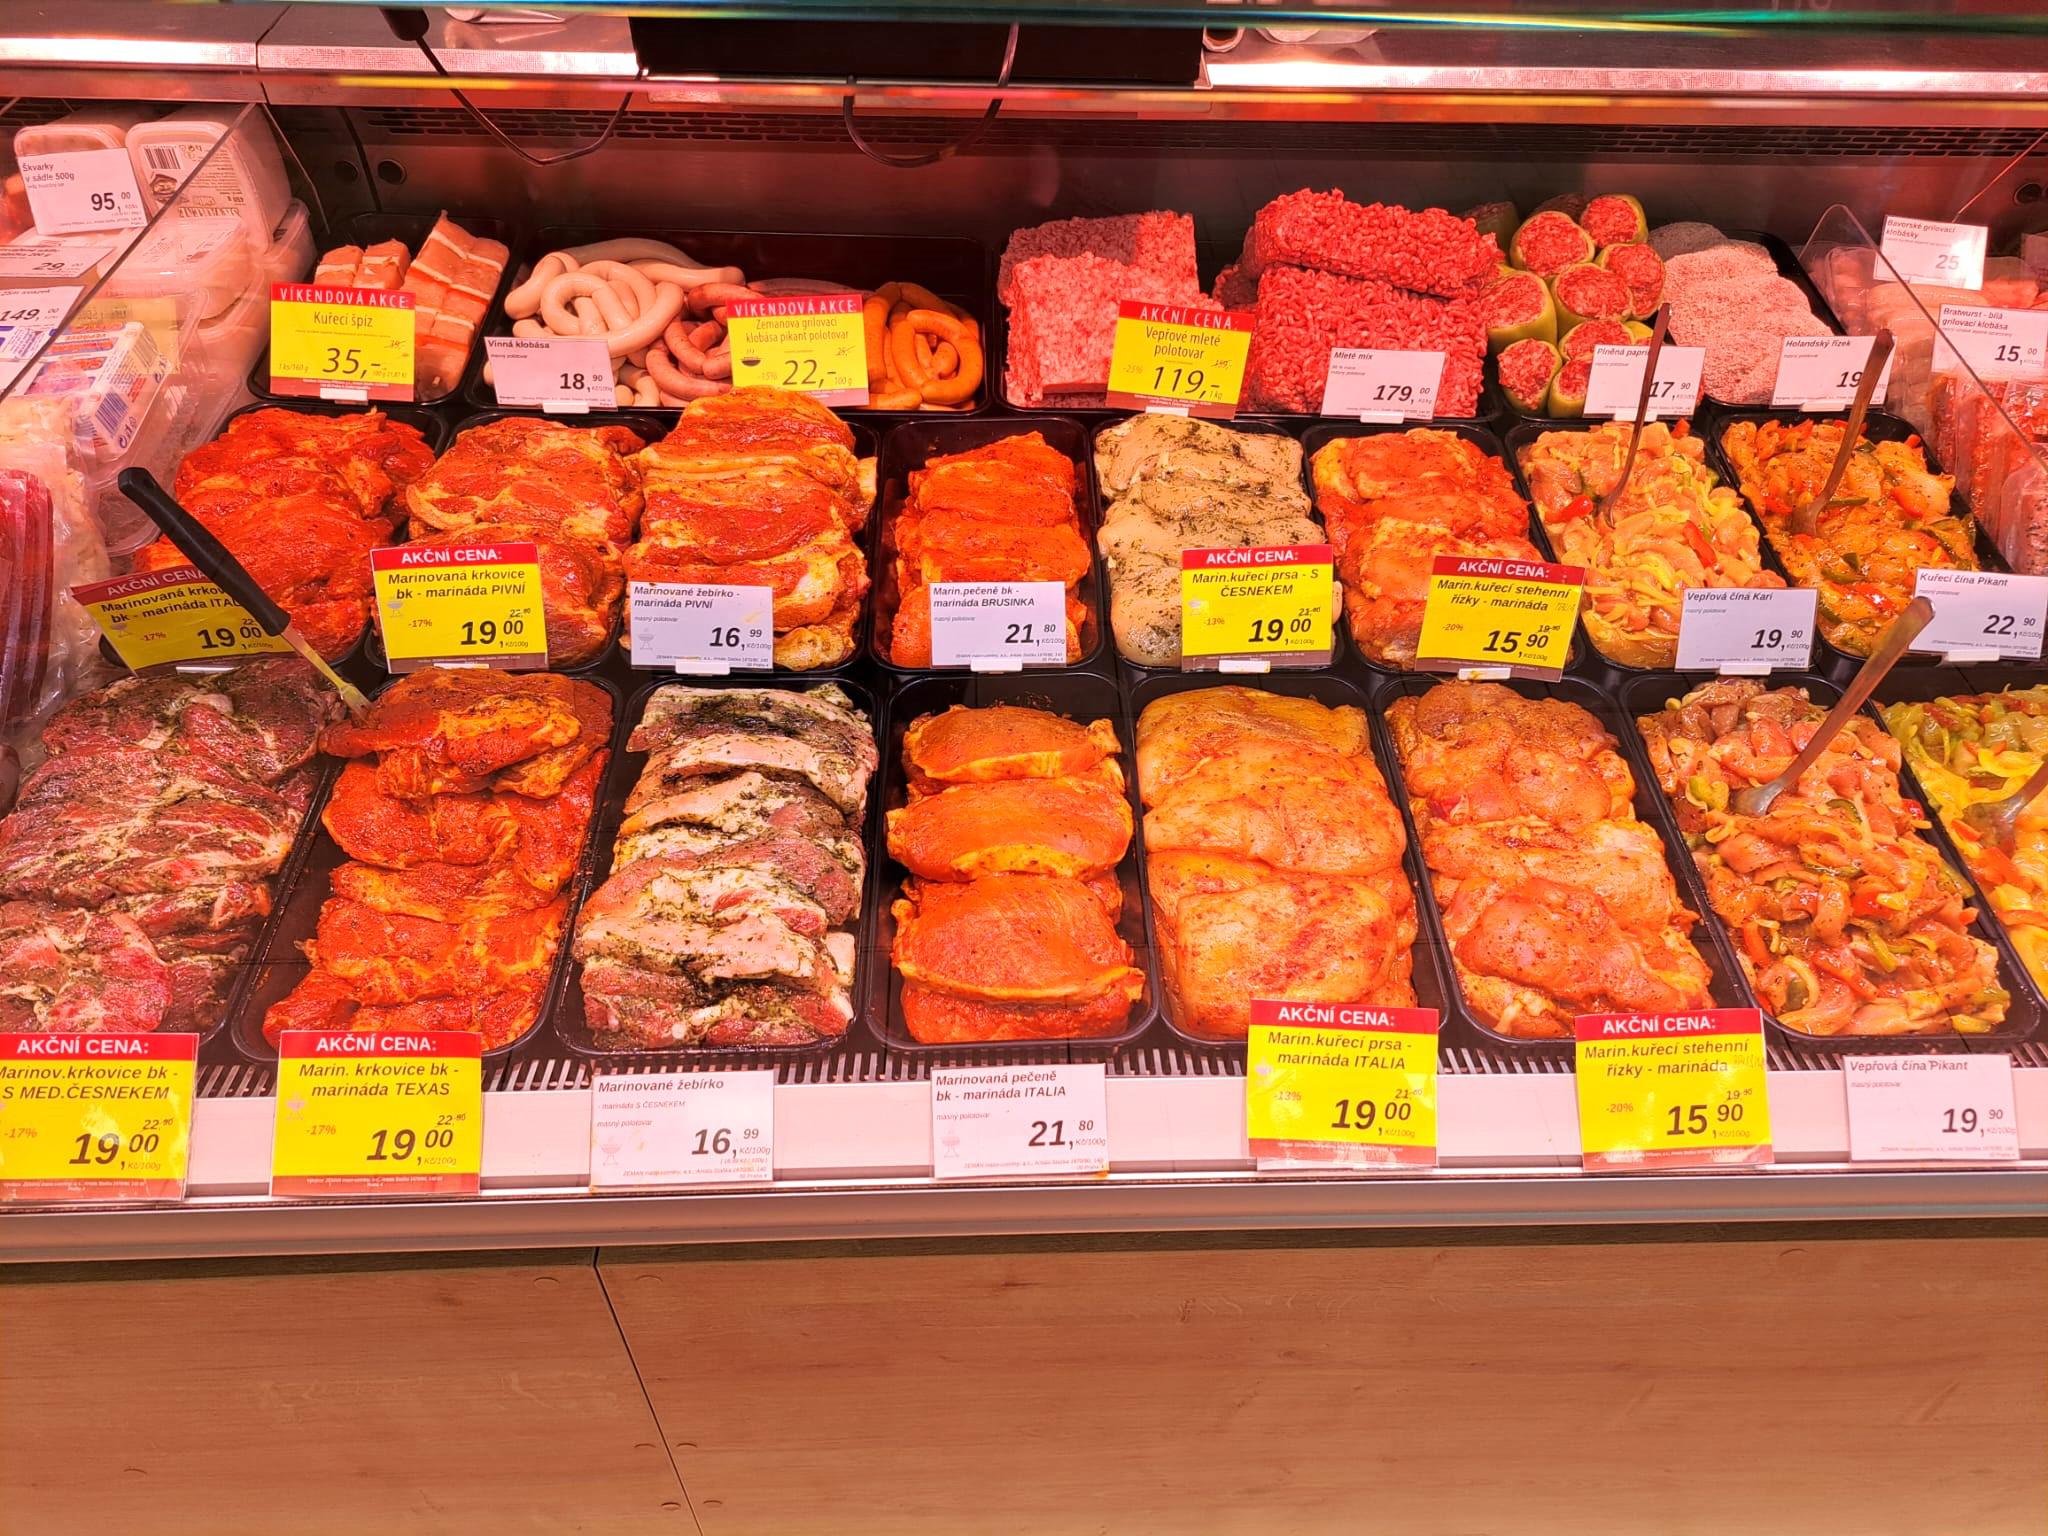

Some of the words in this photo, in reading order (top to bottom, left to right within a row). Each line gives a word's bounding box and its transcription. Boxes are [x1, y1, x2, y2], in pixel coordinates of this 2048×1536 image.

[22, 162, 54, 172] Škvarky
[32, 173, 54, 181] sádle
[55, 172, 75, 181] 500g
[1885, 229, 1919, 239] klobásky
[1887, 220, 1922, 230] Bavorské
[1923, 224, 1956, 233] grilovací
[280, 287, 364, 305] VÍKENDOVÁ
[735, 300, 815, 317] VÍKENDOVÁ
[1140, 306, 1188, 325] AKČNÍ
[1943, 307, 1982, 318] Bratwurst
[1988, 311, 2003, 320] bílá
[314, 312, 348, 325] Kuřecí
[756, 318, 800, 330] Zemanova
[802, 318, 837, 330] grilovací
[1942, 318, 1976, 327] grilovací
[1978, 320, 2008, 330] klobása
[746, 332, 778, 343] klobása
[780, 331, 807, 344] pikant
[810, 330, 849, 342] polotovar
[1146, 325, 1187, 342] Vepřové
[1190, 332, 1221, 346] mleté
[488, 340, 514, 348] Vinná
[516, 340, 550, 349] klobása
[1154, 344, 1204, 359] polotovar
[1785, 340, 1829, 348] Holandský
[1334, 351, 1356, 360] Mleté
[1357, 352, 1373, 360] mix
[1597, 348, 1624, 356] Plněná
[401, 547, 450, 564] AKČNÍ
[454, 548, 502, 562] CENA:
[1206, 549, 1251, 565] AKČNÍ
[1254, 550, 1299, 563] CENA:
[1192, 571, 1268, 584] Marin.kuřecí
[1271, 571, 1298, 583] prsa
[1310, 569, 1319, 579] S
[1457, 560, 1502, 574] AKČNÍ
[1505, 564, 1550, 578] CENA:
[388, 571, 467, 585] Marinovaná
[472, 569, 525, 581] krkovice
[1920, 572, 1953, 582] Kuřecí
[1954, 575, 1975, 584] čína
[1977, 577, 2008, 587] Pikant
[107, 574, 161, 596] AKČNÍ
[396, 588, 413, 600] bk
[426, 585, 487, 598] marináda
[491, 581, 525, 594] PIVNÍ
[634, 586, 694, 597] Marinované
[697, 587, 734, 598] žebírko
[933, 586, 999, 597] Marin.pečeně
[1001, 586, 1013, 595] bk
[1220, 583, 1294, 597] ČESNEKEM
[1437, 579, 1513, 593] Marin.kuřecí
[1515, 585, 1571, 599] stehenní
[101, 588, 185, 612] Marinovaná
[634, 599, 682, 609] marináda
[684, 599, 713, 609] PIVNÍ
[933, 599, 979, 608] marináda
[981, 598, 1035, 607] BRUSINKA
[1450, 594, 1480, 608] řízky
[1491, 598, 1549, 612] marináda
[1687, 592, 1727, 603] Vepřová
[1729, 591, 1750, 601] čína
[1752, 592, 1773, 601] Kari
[111, 612, 130, 624] bk
[142, 600, 208, 618] marináda
[503, 620, 524, 635] 00
[1044, 624, 1056, 633] 80
[1290, 618, 1311, 633] 00
[2023, 618, 2036, 626] 90
[240, 626, 261, 639] 00
[749, 629, 762, 638] 99
[1791, 630, 1803, 639] 90
[1526, 633, 1549, 648] 90
[1278, 1005, 1335, 1023] AKČNÍ
[1340, 1009, 1395, 1026] CENA:
[1602, 1016, 1659, 1034] AKČNÍ
[1664, 1016, 1716, 1032] CENA:
[16, 1036, 81, 1054] AKČNÍ
[85, 1039, 149, 1054] CENA:
[316, 1033, 376, 1052] AKČNÍ
[380, 1037, 437, 1052] CENA:
[1268, 1032, 1364, 1049] Marin.kuřecí
[1369, 1037, 1402, 1051] prsa
[1585, 1042, 1679, 1059] Marin.kuřecí
[1683, 1038, 1750, 1054] stehenní
[1277, 1053, 1349, 1067] marináda
[1354, 1055, 1405, 1069] ITALIA
[1850, 1060, 1898, 1073] Vepřová
[1901, 1059, 1927, 1071] čína
[1930, 1060, 1968, 1071] Pikant
[147, 1066, 168, 1079] bk
[299, 1064, 349, 1077] Marin.
[355, 1063, 425, 1076] krkovice
[430, 1063, 448, 1076] bk
[1607, 1062, 1643, 1078] řízky
[1657, 1060, 1728, 1074] marináda
[598, 1081, 673, 1093] Marinované
[677, 1078, 724, 1091] žebírko
[936, 1073, 1008, 1086] Marinovaná
[1011, 1071, 1057, 1085] pečeně
[2, 1086, 14, 1099] S
[20, 1083, 170, 1099] MED.ČESNEKEM
[311, 1083, 388, 1097] marináda
[395, 1082, 450, 1096] TEXAS
[936, 1091, 951, 1101] bk
[963, 1087, 1021, 1100] marináda
[1024, 1086, 1066, 1097] ITALIA
[643, 1100, 686, 1109] ČESNEKEM
[1384, 1101, 1411, 1121] 00
[1717, 1103, 1743, 1122] 90
[1988, 1109, 2003, 1120] 90
[1078, 1120, 1094, 1131] 80
[425, 1129, 454, 1148] 00
[743, 1128, 759, 1139] 99
[128, 1133, 160, 1153] 00
